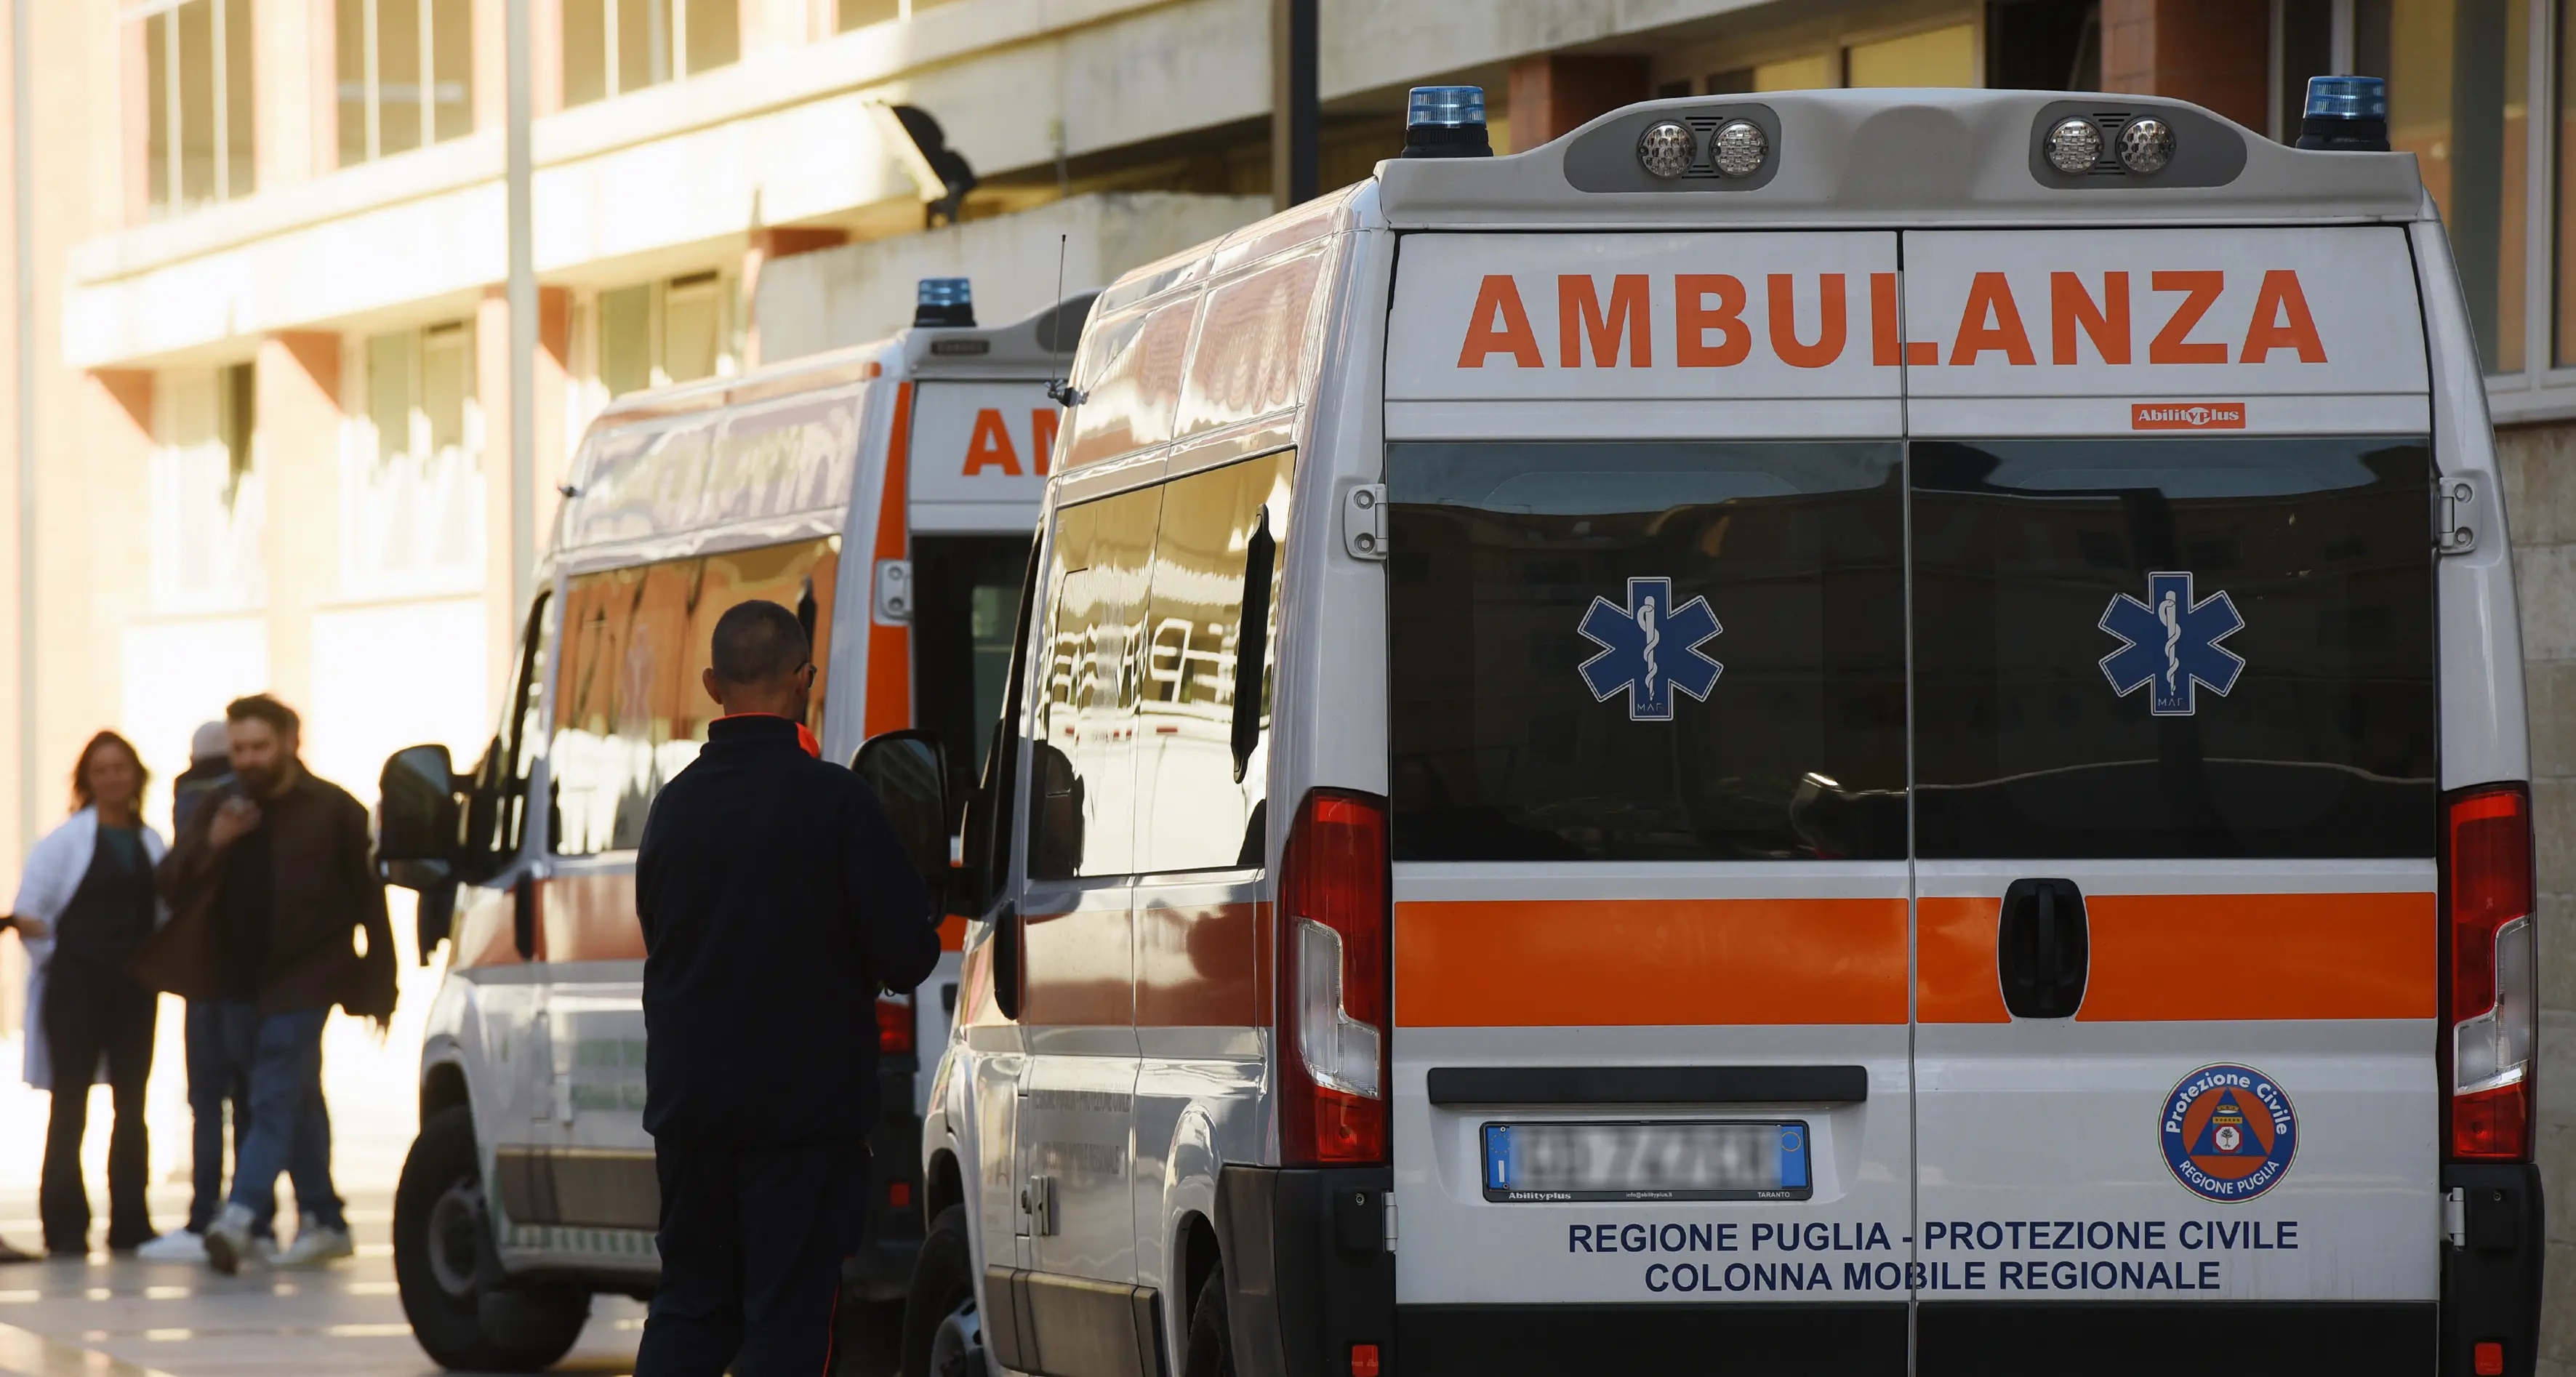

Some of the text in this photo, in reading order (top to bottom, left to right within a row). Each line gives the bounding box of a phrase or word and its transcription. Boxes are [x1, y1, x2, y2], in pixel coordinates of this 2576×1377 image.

[1457, 270, 2327, 368] AMBULANZA
[2165, 1072, 2292, 1135] Protezione Civile
[2179, 1160, 2280, 1195] REGIONE PUGLIA
[1508, 1191, 1572, 1201] Abilityplus
[1569, 1223, 1738, 1253] REGIONE
[1752, 1222, 1891, 1251] PUGLIA
[1925, 1221, 2166, 1250] PROTEZIONE
[2179, 1221, 2298, 1250] CIVILE
[1645, 1261, 2220, 1293] COLONNA MOBILE REGIONALE
